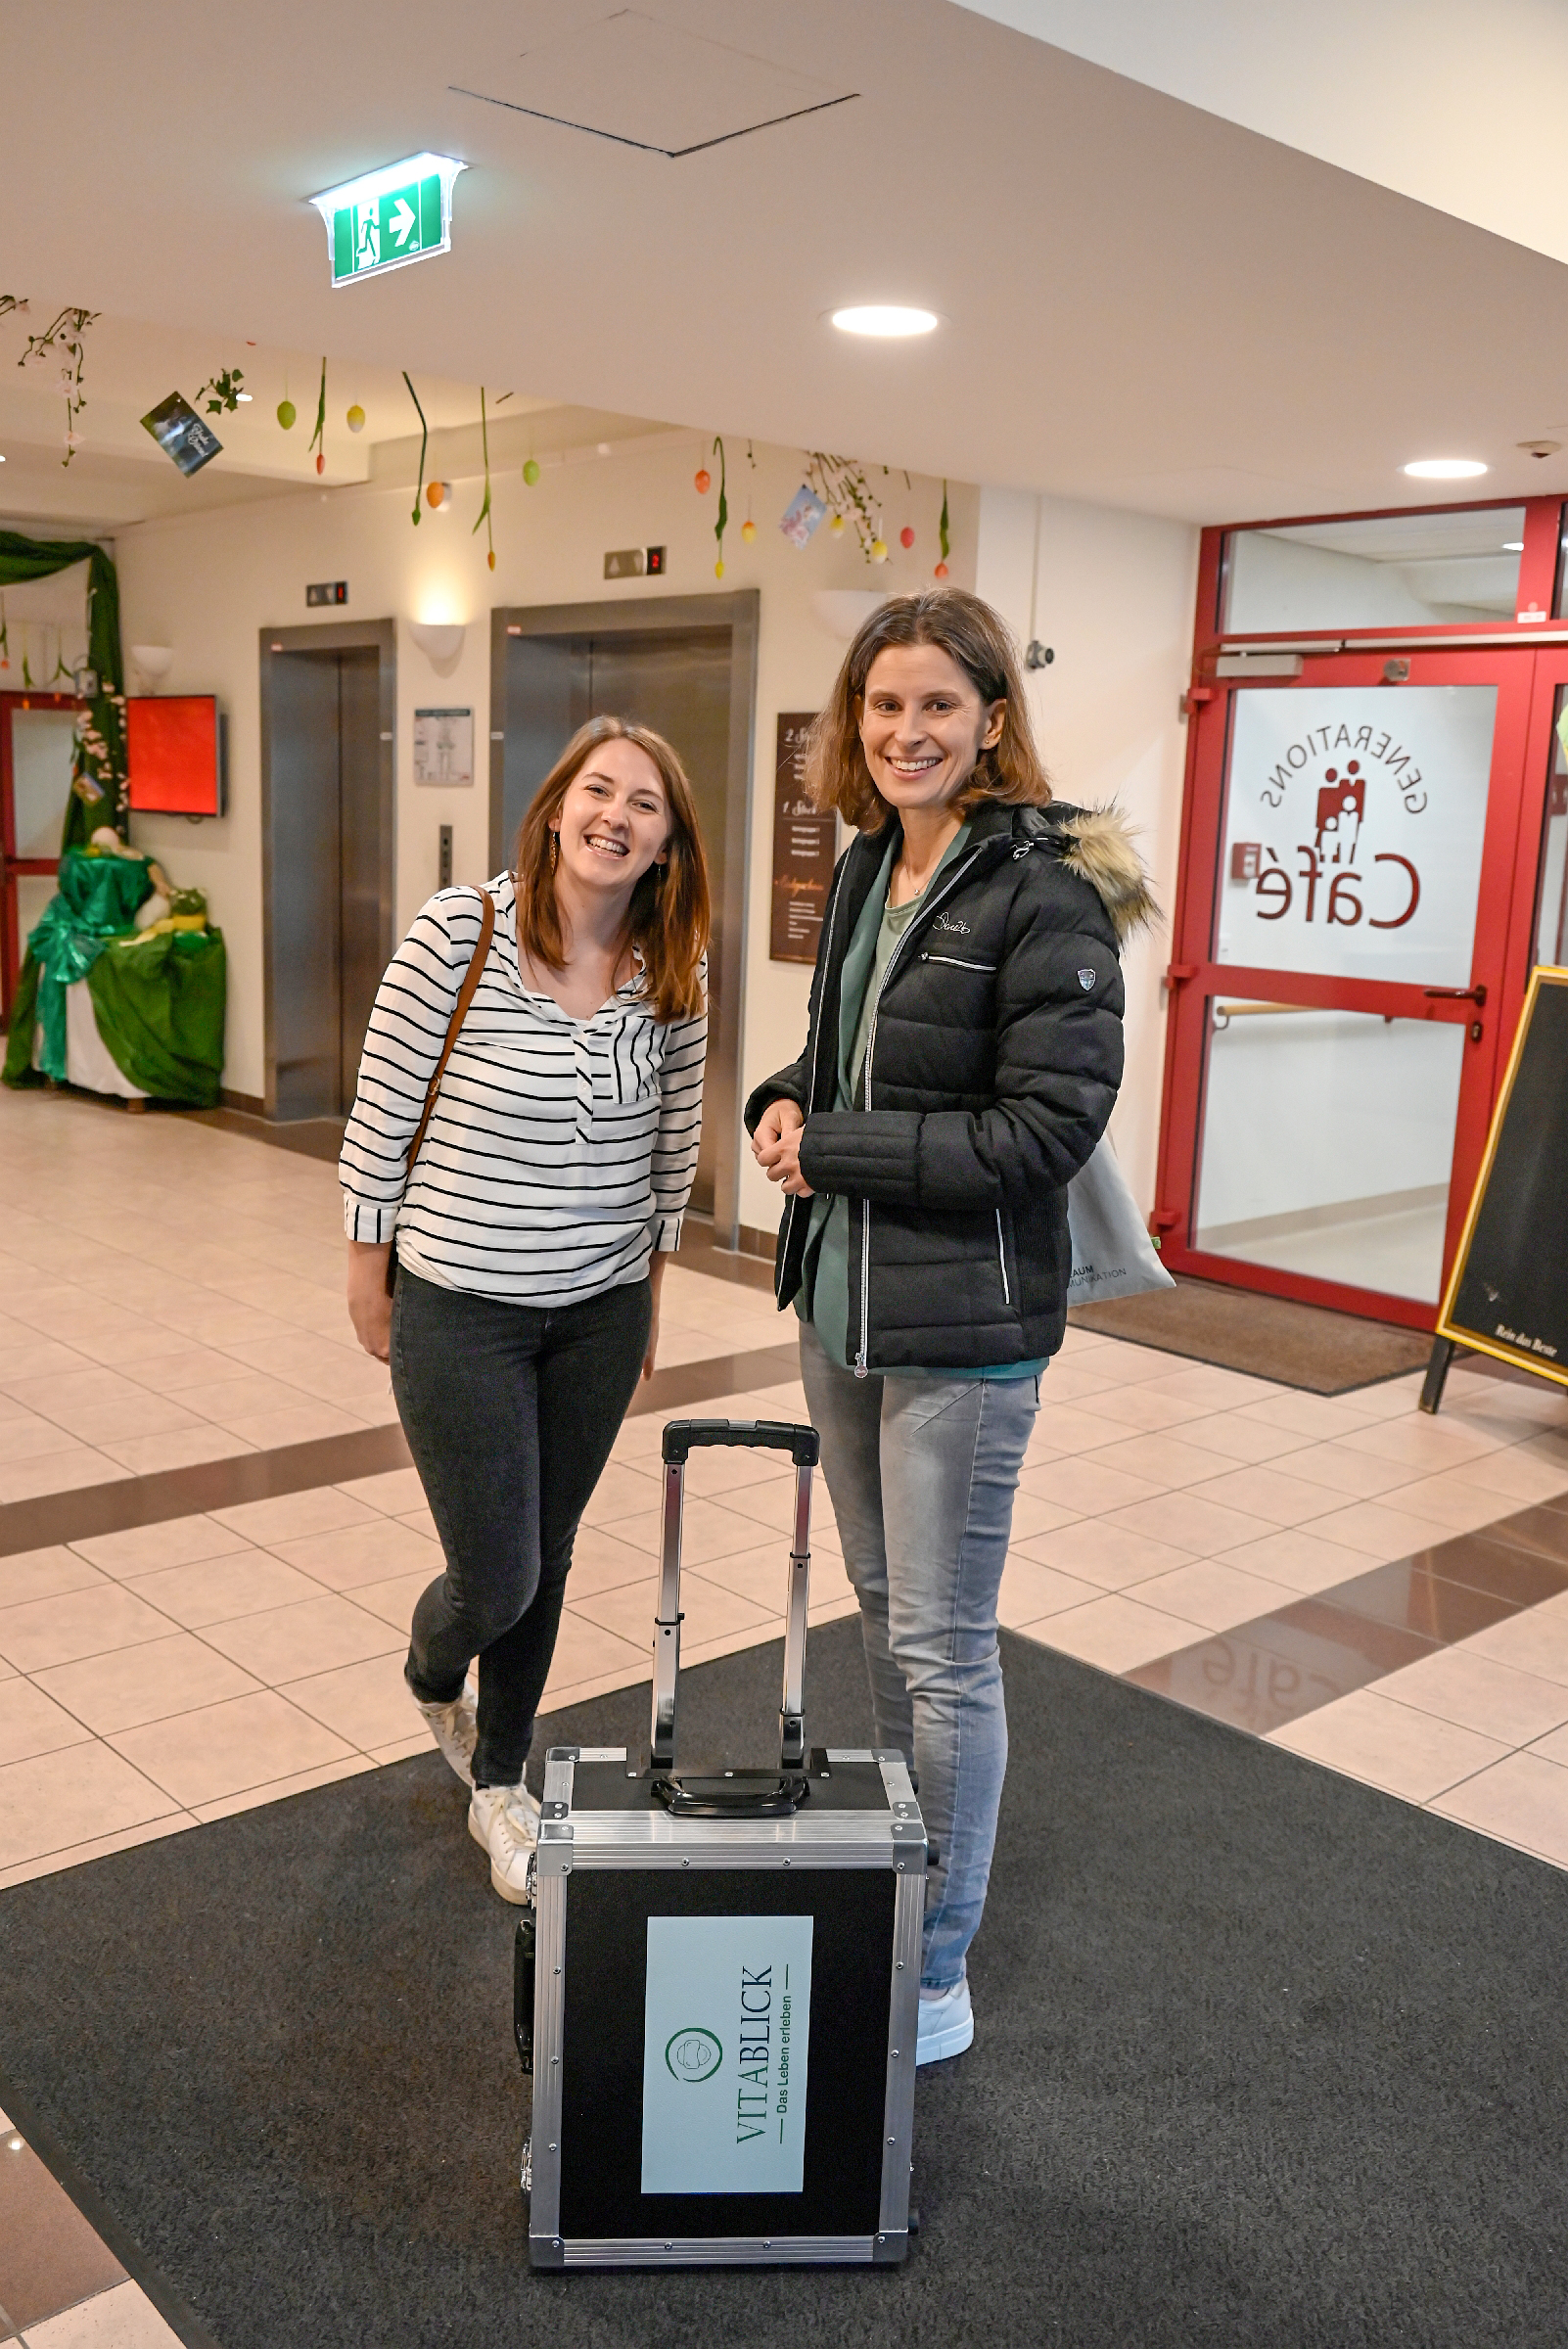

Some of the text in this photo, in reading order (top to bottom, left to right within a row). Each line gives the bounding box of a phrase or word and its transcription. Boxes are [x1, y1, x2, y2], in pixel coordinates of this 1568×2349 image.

[1071, 1265, 1094, 1277] AUM
[736, 1965, 772, 2143] VITABLICK
[776, 1995, 792, 2114] Das Leben erleben
